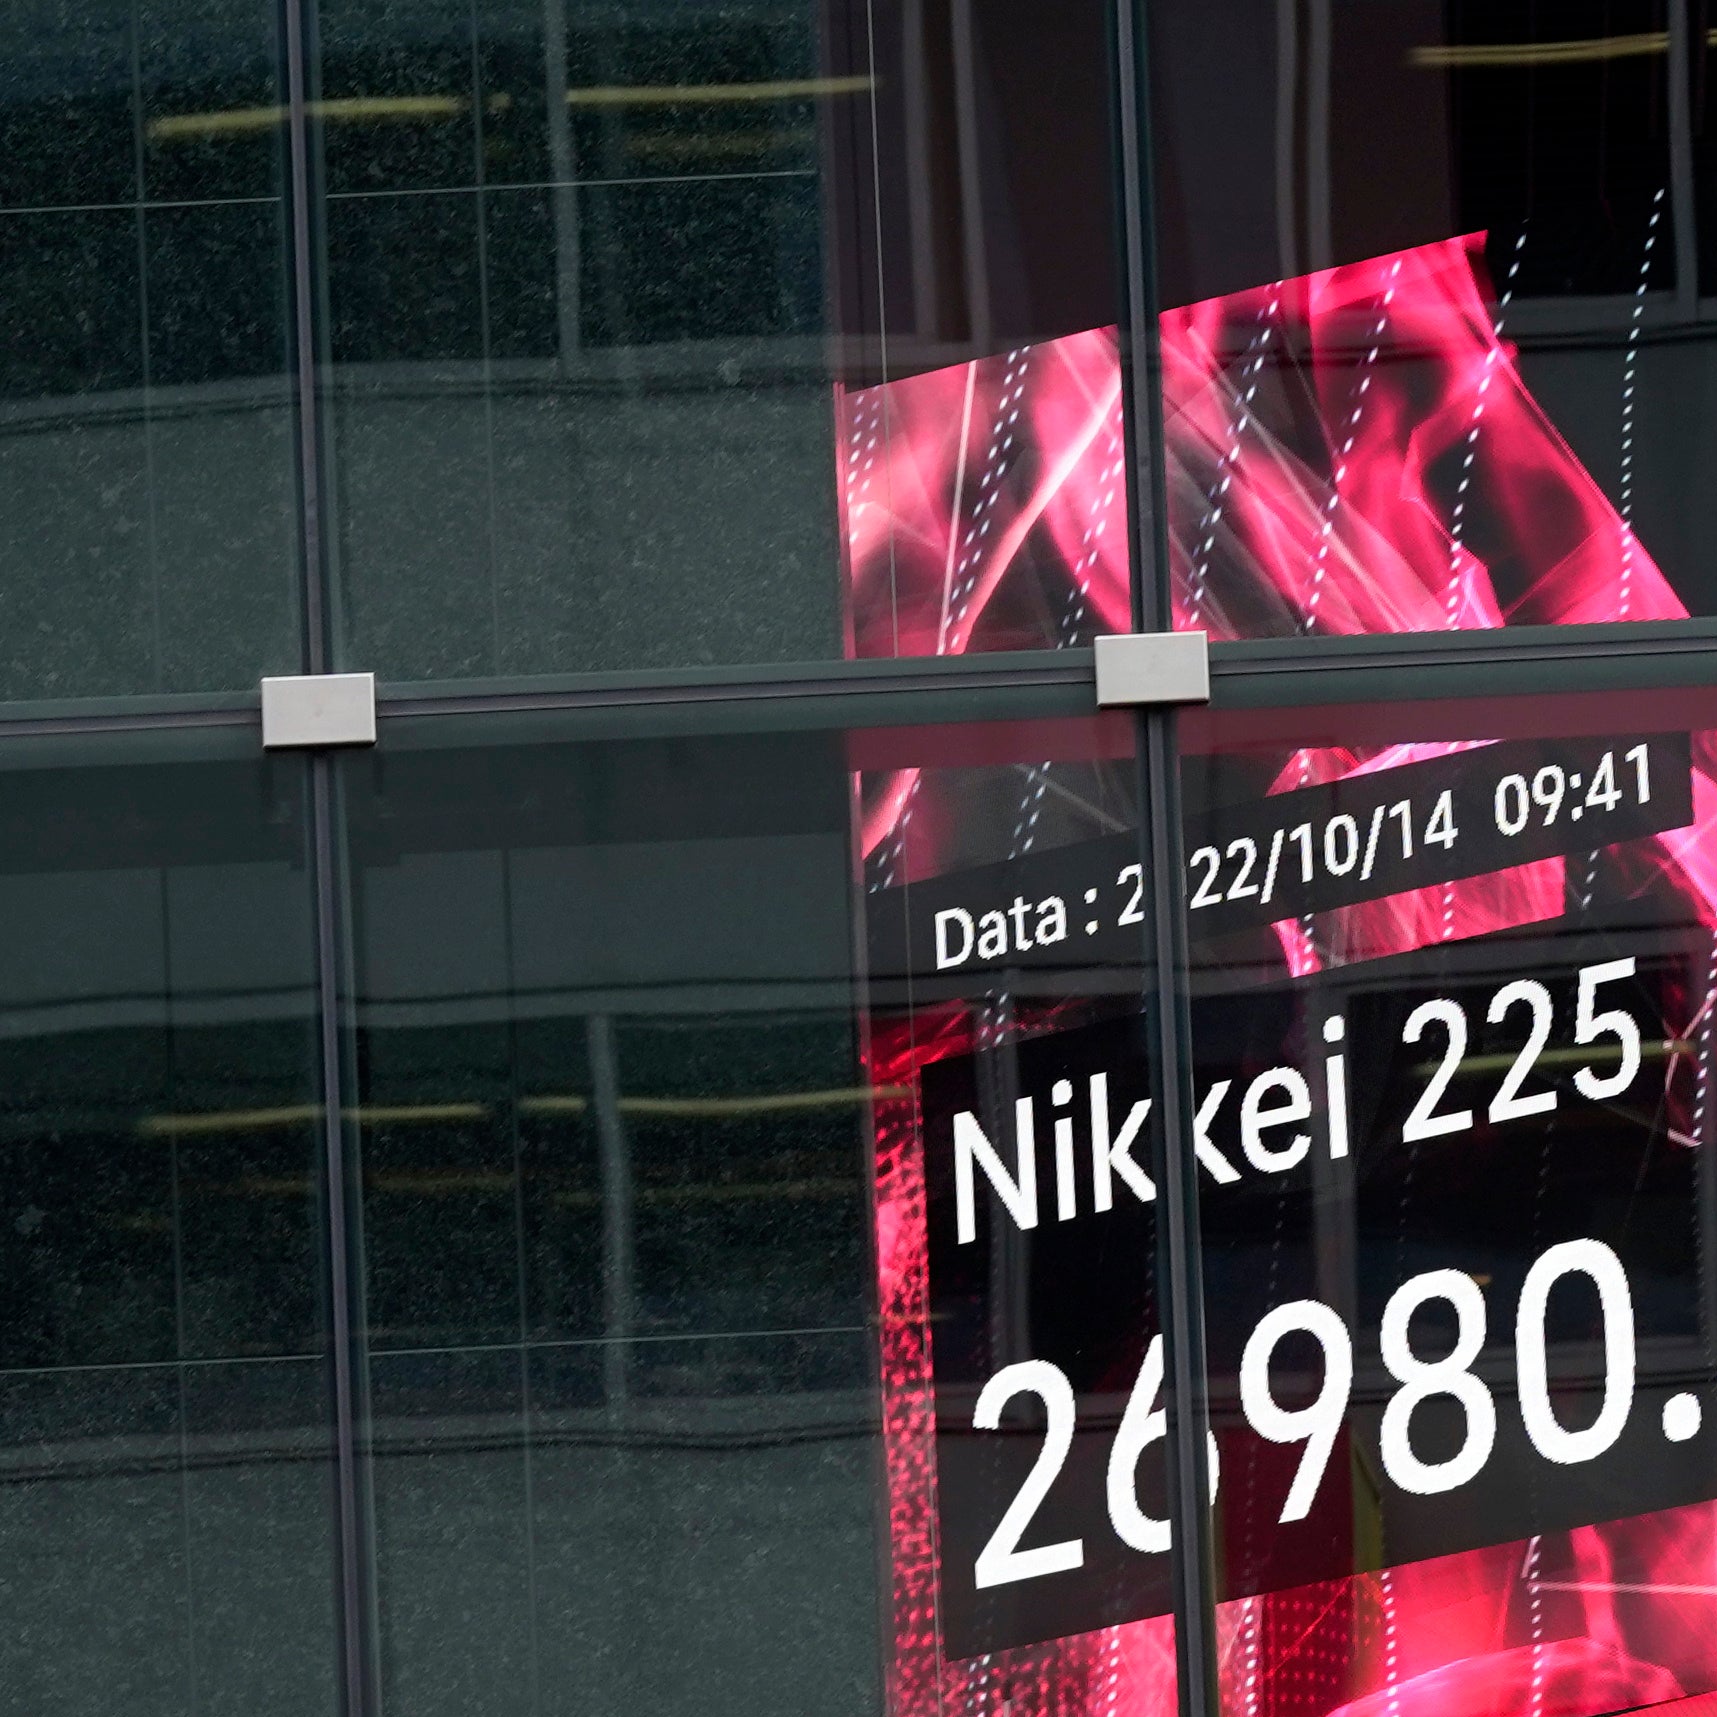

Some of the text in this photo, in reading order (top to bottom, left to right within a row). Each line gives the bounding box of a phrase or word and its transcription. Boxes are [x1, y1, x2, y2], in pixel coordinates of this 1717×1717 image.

[1117, 790, 1459, 927] 222/10/14
[1493, 739, 1650, 836] 09:41
[953, 956, 1642, 1245] Nikkei 225
